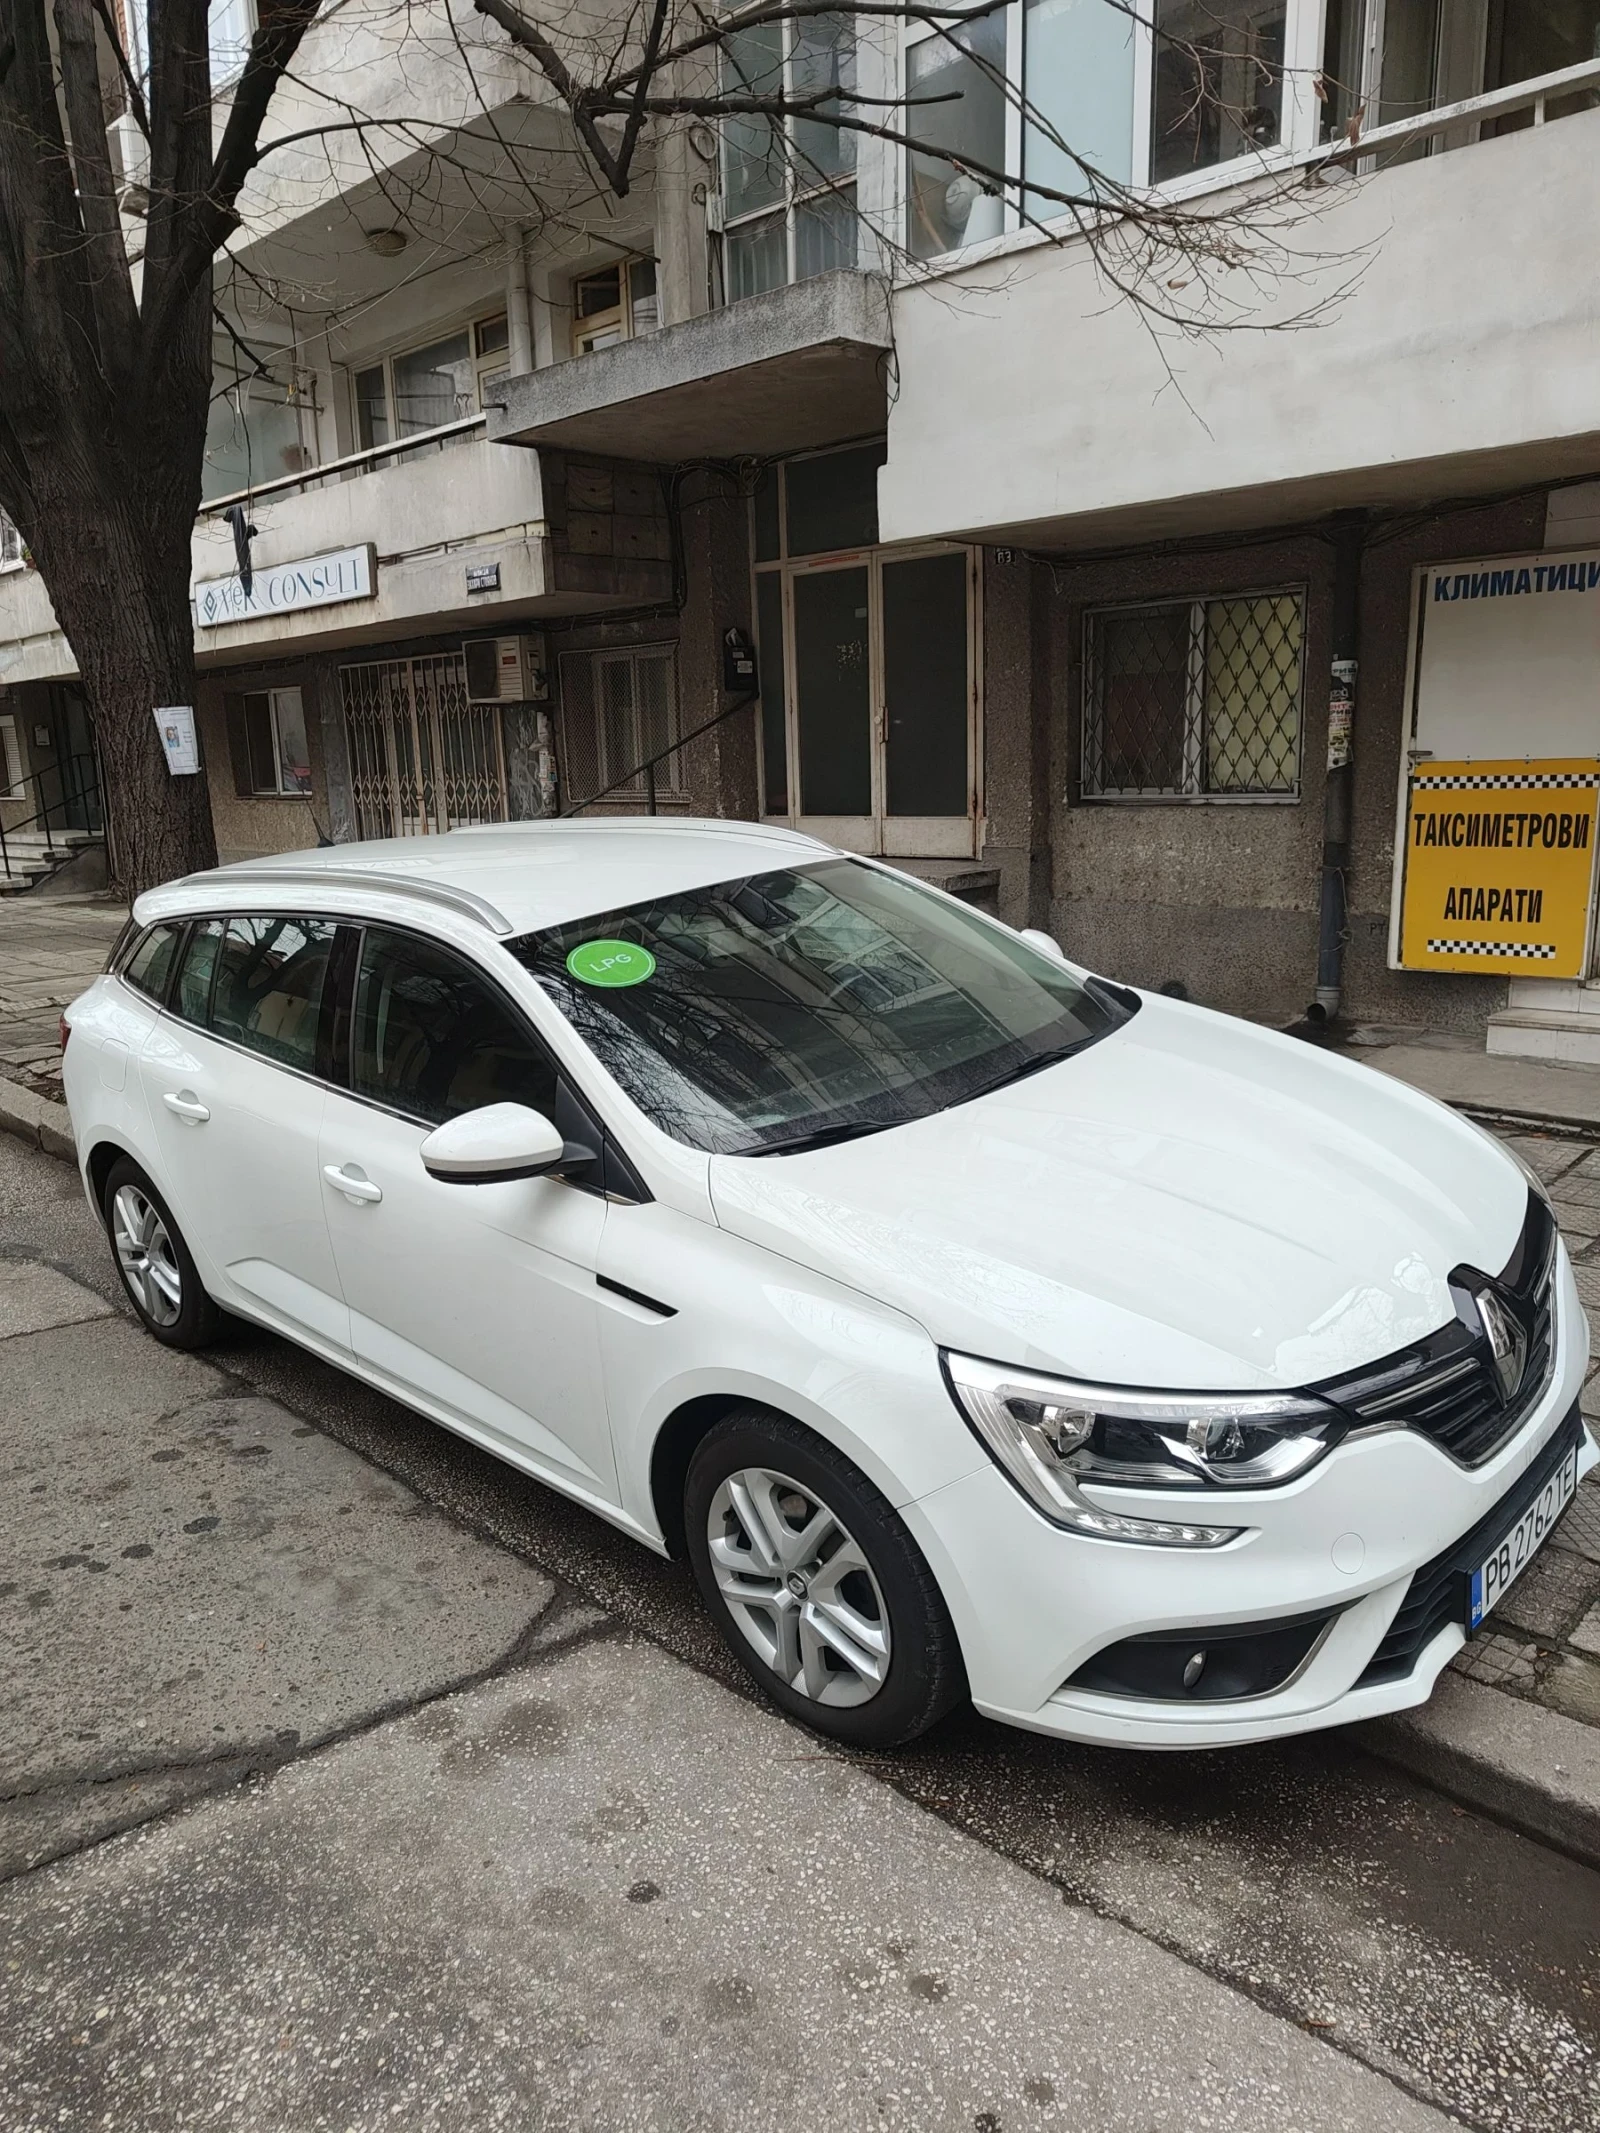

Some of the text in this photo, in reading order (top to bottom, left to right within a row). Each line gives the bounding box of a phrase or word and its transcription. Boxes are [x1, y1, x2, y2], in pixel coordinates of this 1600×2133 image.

[268, 558, 361, 607] CONSULT
[1434, 561, 1600, 602] КЛИМАТИЦИ
[1414, 813, 1590, 848] ТАКСИМЕТРОВИ
[1443, 887, 1543, 923] АПАРАТИ
[588, 953, 632, 973] LPG
[1485, 1452, 1574, 1606] PB 2762 TE
[1471, 1600, 1482, 1620] BG
